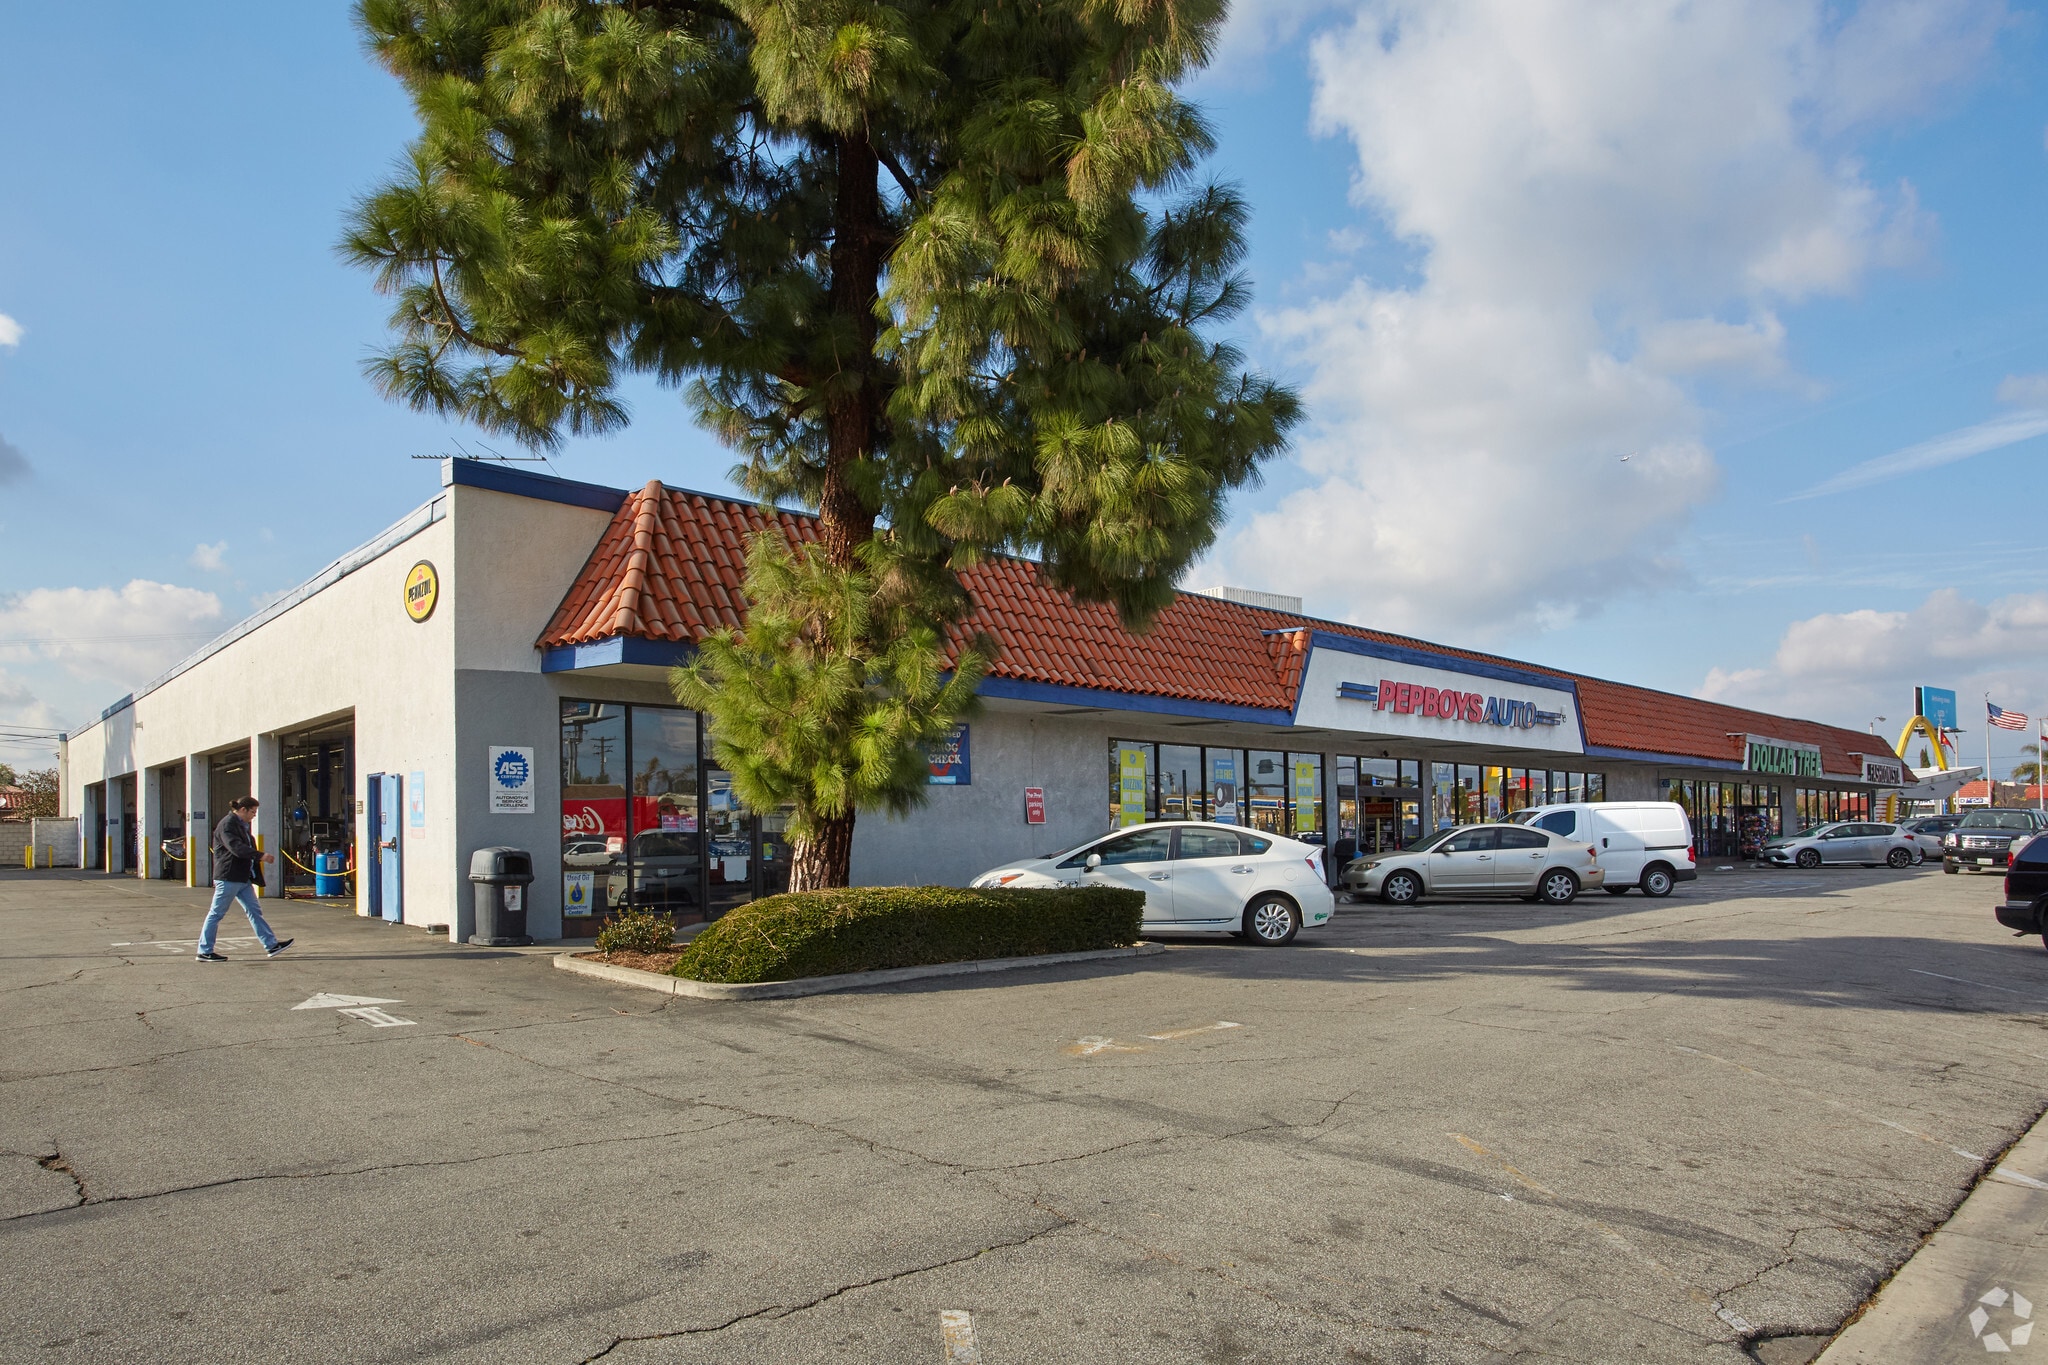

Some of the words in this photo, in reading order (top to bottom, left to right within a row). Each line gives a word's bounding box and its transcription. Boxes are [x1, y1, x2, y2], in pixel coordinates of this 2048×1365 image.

[1378, 679, 1484, 723] PEPBOYS
[1482, 696, 1537, 729] AUTO
[928, 753, 962, 764] CHECK
[1752, 743, 1794, 775] DOLLAR
[1797, 751, 1821, 777] TREE
[499, 761, 524, 775] ASE
[582, 873, 590, 881] Oil
